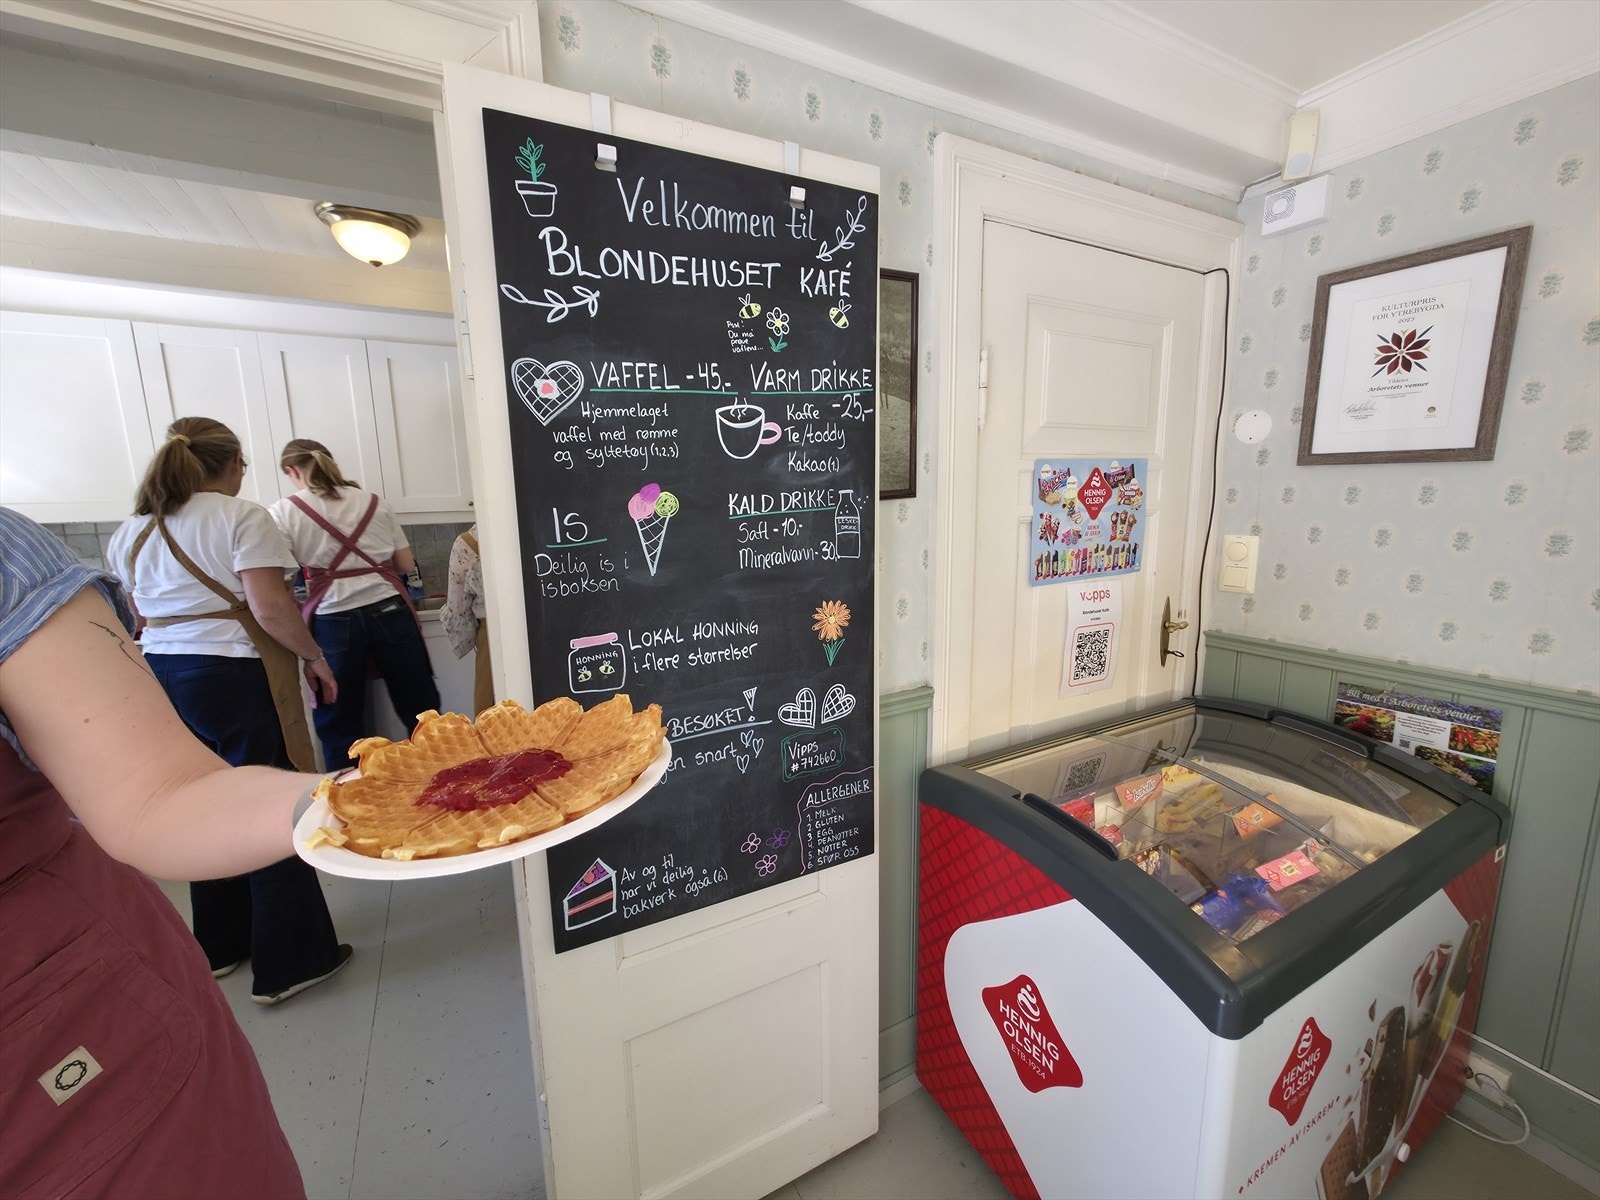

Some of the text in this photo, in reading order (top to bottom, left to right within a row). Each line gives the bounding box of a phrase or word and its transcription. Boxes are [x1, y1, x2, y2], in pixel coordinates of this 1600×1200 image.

[616, 177, 816, 241] Velkommen til
[538, 226, 852, 298] BLONDEHUSET KAFÉ
[1372, 304, 1445, 321] FOR YTREBYGDA
[1382, 297, 1437, 312] KULTURPRIS
[727, 330, 738, 339] Du
[590, 361, 680, 390] VAFFEL
[750, 361, 801, 392] VARM
[1367, 384, 1403, 393] Arboretets
[580, 401, 669, 426] Hjemmelaget
[787, 403, 820, 420] Kaffe
[553, 426, 679, 444] vaffel med rømme
[554, 450, 574, 470] og
[728, 493, 774, 516] KALD
[1084, 489, 1106, 497] HENNIG
[737, 521, 769, 543] Saft
[534, 552, 629, 582] Deilig is i
[541, 577, 620, 598] isboksen
[628, 626, 684, 650] LOKAL
[633, 643, 758, 674] i flere størrelser
[1346, 689, 1362, 698] Bli
[1361, 693, 1381, 702] med
[1387, 697, 1442, 715] Arboretets
[1445, 709, 1482, 722] venner
[695, 742, 737, 765] snart
[788, 741, 819, 760] Vipps
[806, 779, 870, 807] ALLERGENER
[815, 807, 836, 819] MELK
[815, 814, 845, 829] GLUTEN
[817, 827, 834, 838] EGG
[817, 851, 841, 866] SPØR
[844, 845, 860, 858] OSS
[621, 854, 674, 885] Av og til
[621, 865, 693, 900] har vi deilig
[623, 889, 676, 919] bakverk
[1000, 999, 1060, 1061] HENNIG
[1003, 1020, 1054, 1074] OLSEN
[1282, 1047, 1321, 1089] HENNIG
[1283, 1065, 1316, 1101] OLSEN
[1247, 1101, 1335, 1188] KREMEN AV ISKREM
